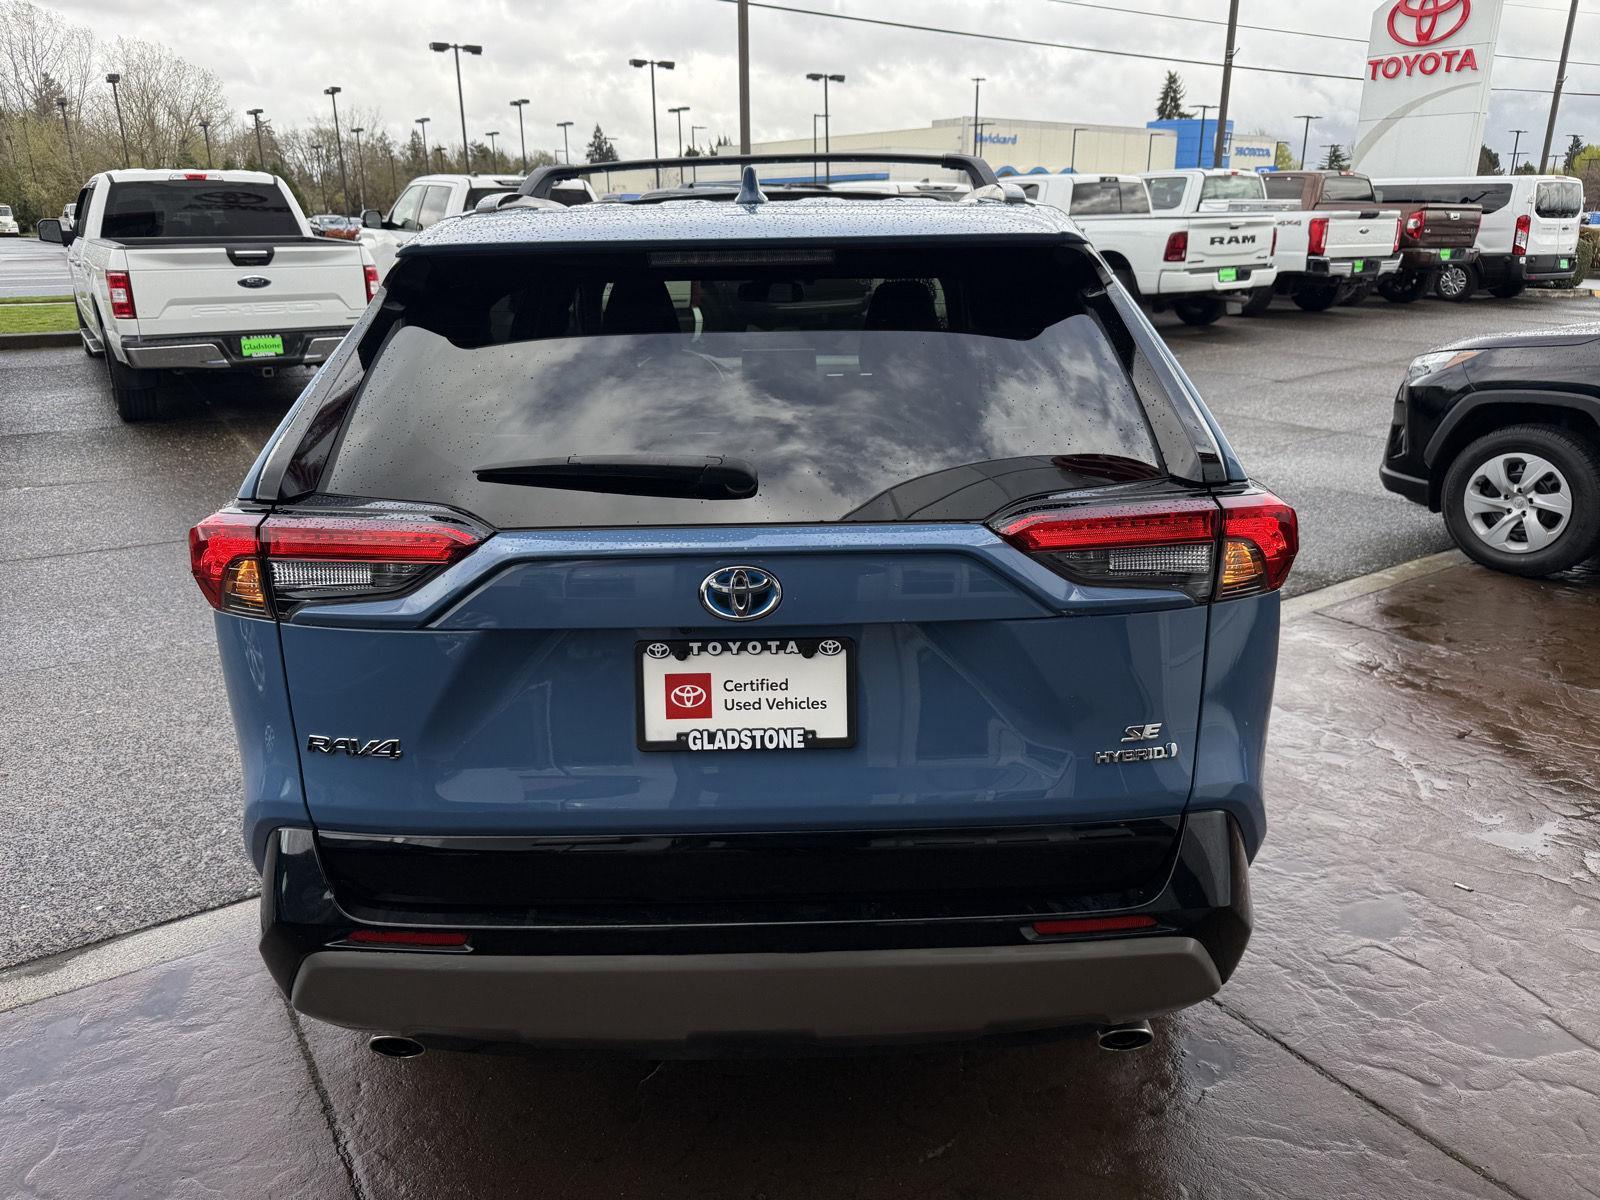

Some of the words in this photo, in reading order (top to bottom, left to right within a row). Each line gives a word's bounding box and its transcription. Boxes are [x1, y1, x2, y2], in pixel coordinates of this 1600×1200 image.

[1368, 48, 1478, 81] TOYOTA
[1235, 146, 1271, 157] HONDA
[1210, 235, 1256, 246] RAM
[243, 343, 281, 351] Gladstone
[689, 641, 800, 655] TOYOTA
[723, 678, 789, 692] Certified
[724, 698, 762, 711] Used
[765, 697, 827, 711] Vehicles
[687, 728, 806, 751] GLADSTONE
[1120, 723, 1162, 742] SE
[307, 734, 403, 760] RAV4
[1094, 746, 1168, 764] HYBRID
